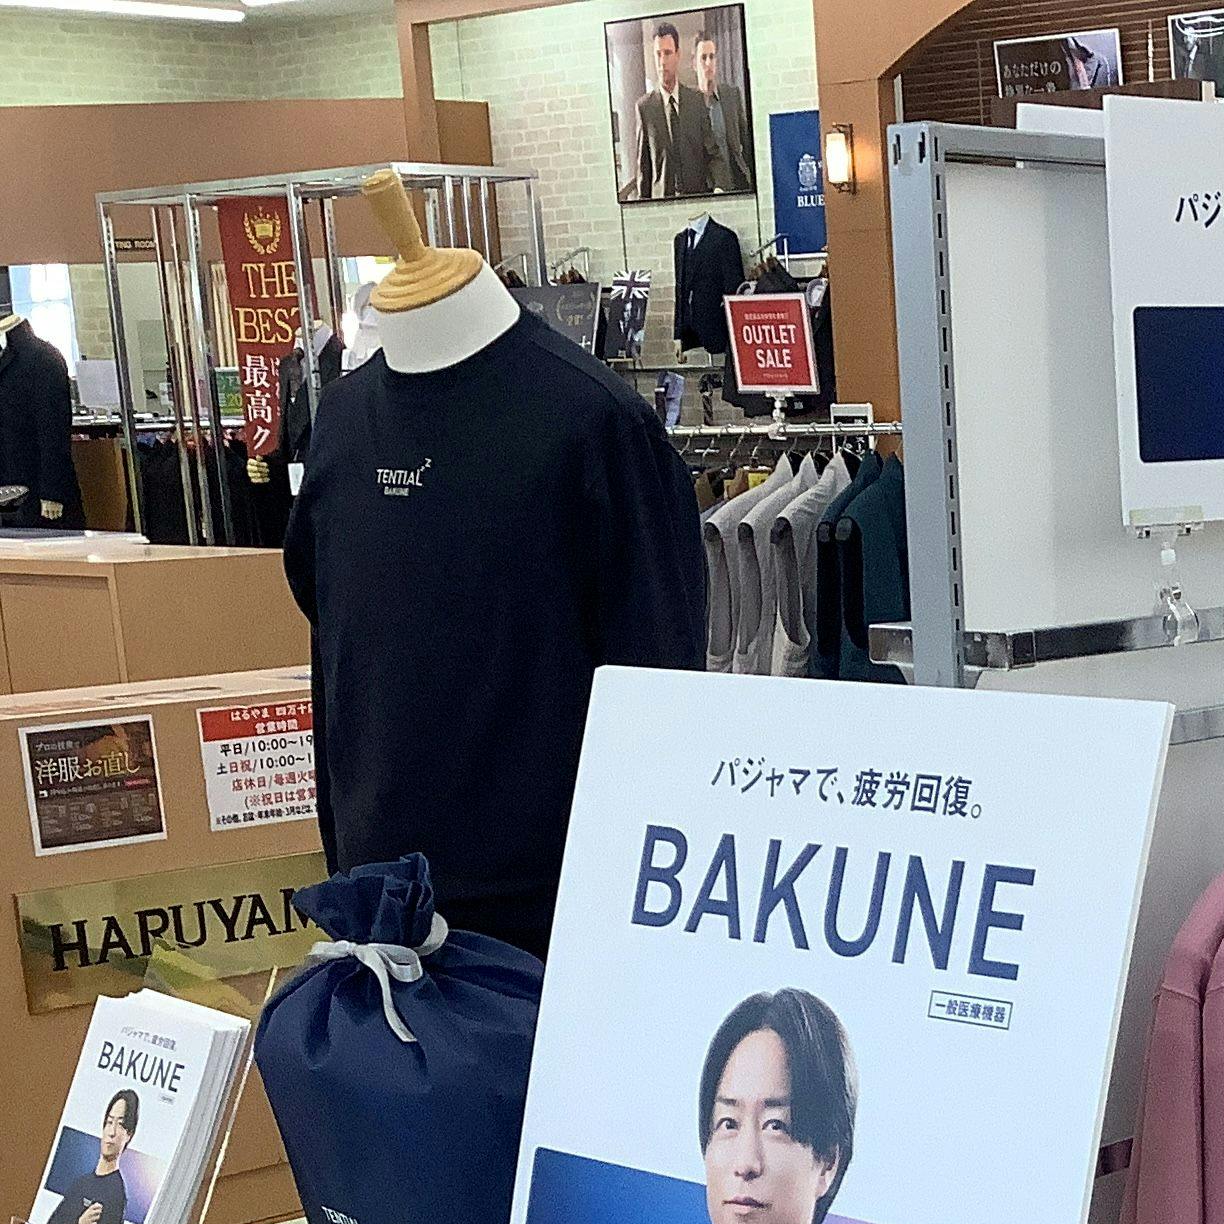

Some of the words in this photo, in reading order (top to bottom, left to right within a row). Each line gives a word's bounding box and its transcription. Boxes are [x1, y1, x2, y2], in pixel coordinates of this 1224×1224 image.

[241, 261, 299, 299] THE
[742, 324, 796, 345] OUTLET
[755, 348, 793, 369] SALE
[376, 468, 423, 487] TENTIAL
[230, 707, 270, 722] はるやま
[255, 718, 298, 735] 営業時間
[34, 751, 140, 785] 洋服お直し
[711, 757, 982, 819] パジャマで、疲労回復。
[630, 824, 1037, 981] BAKUNE
[97, 1040, 185, 1093] BAKUNE
